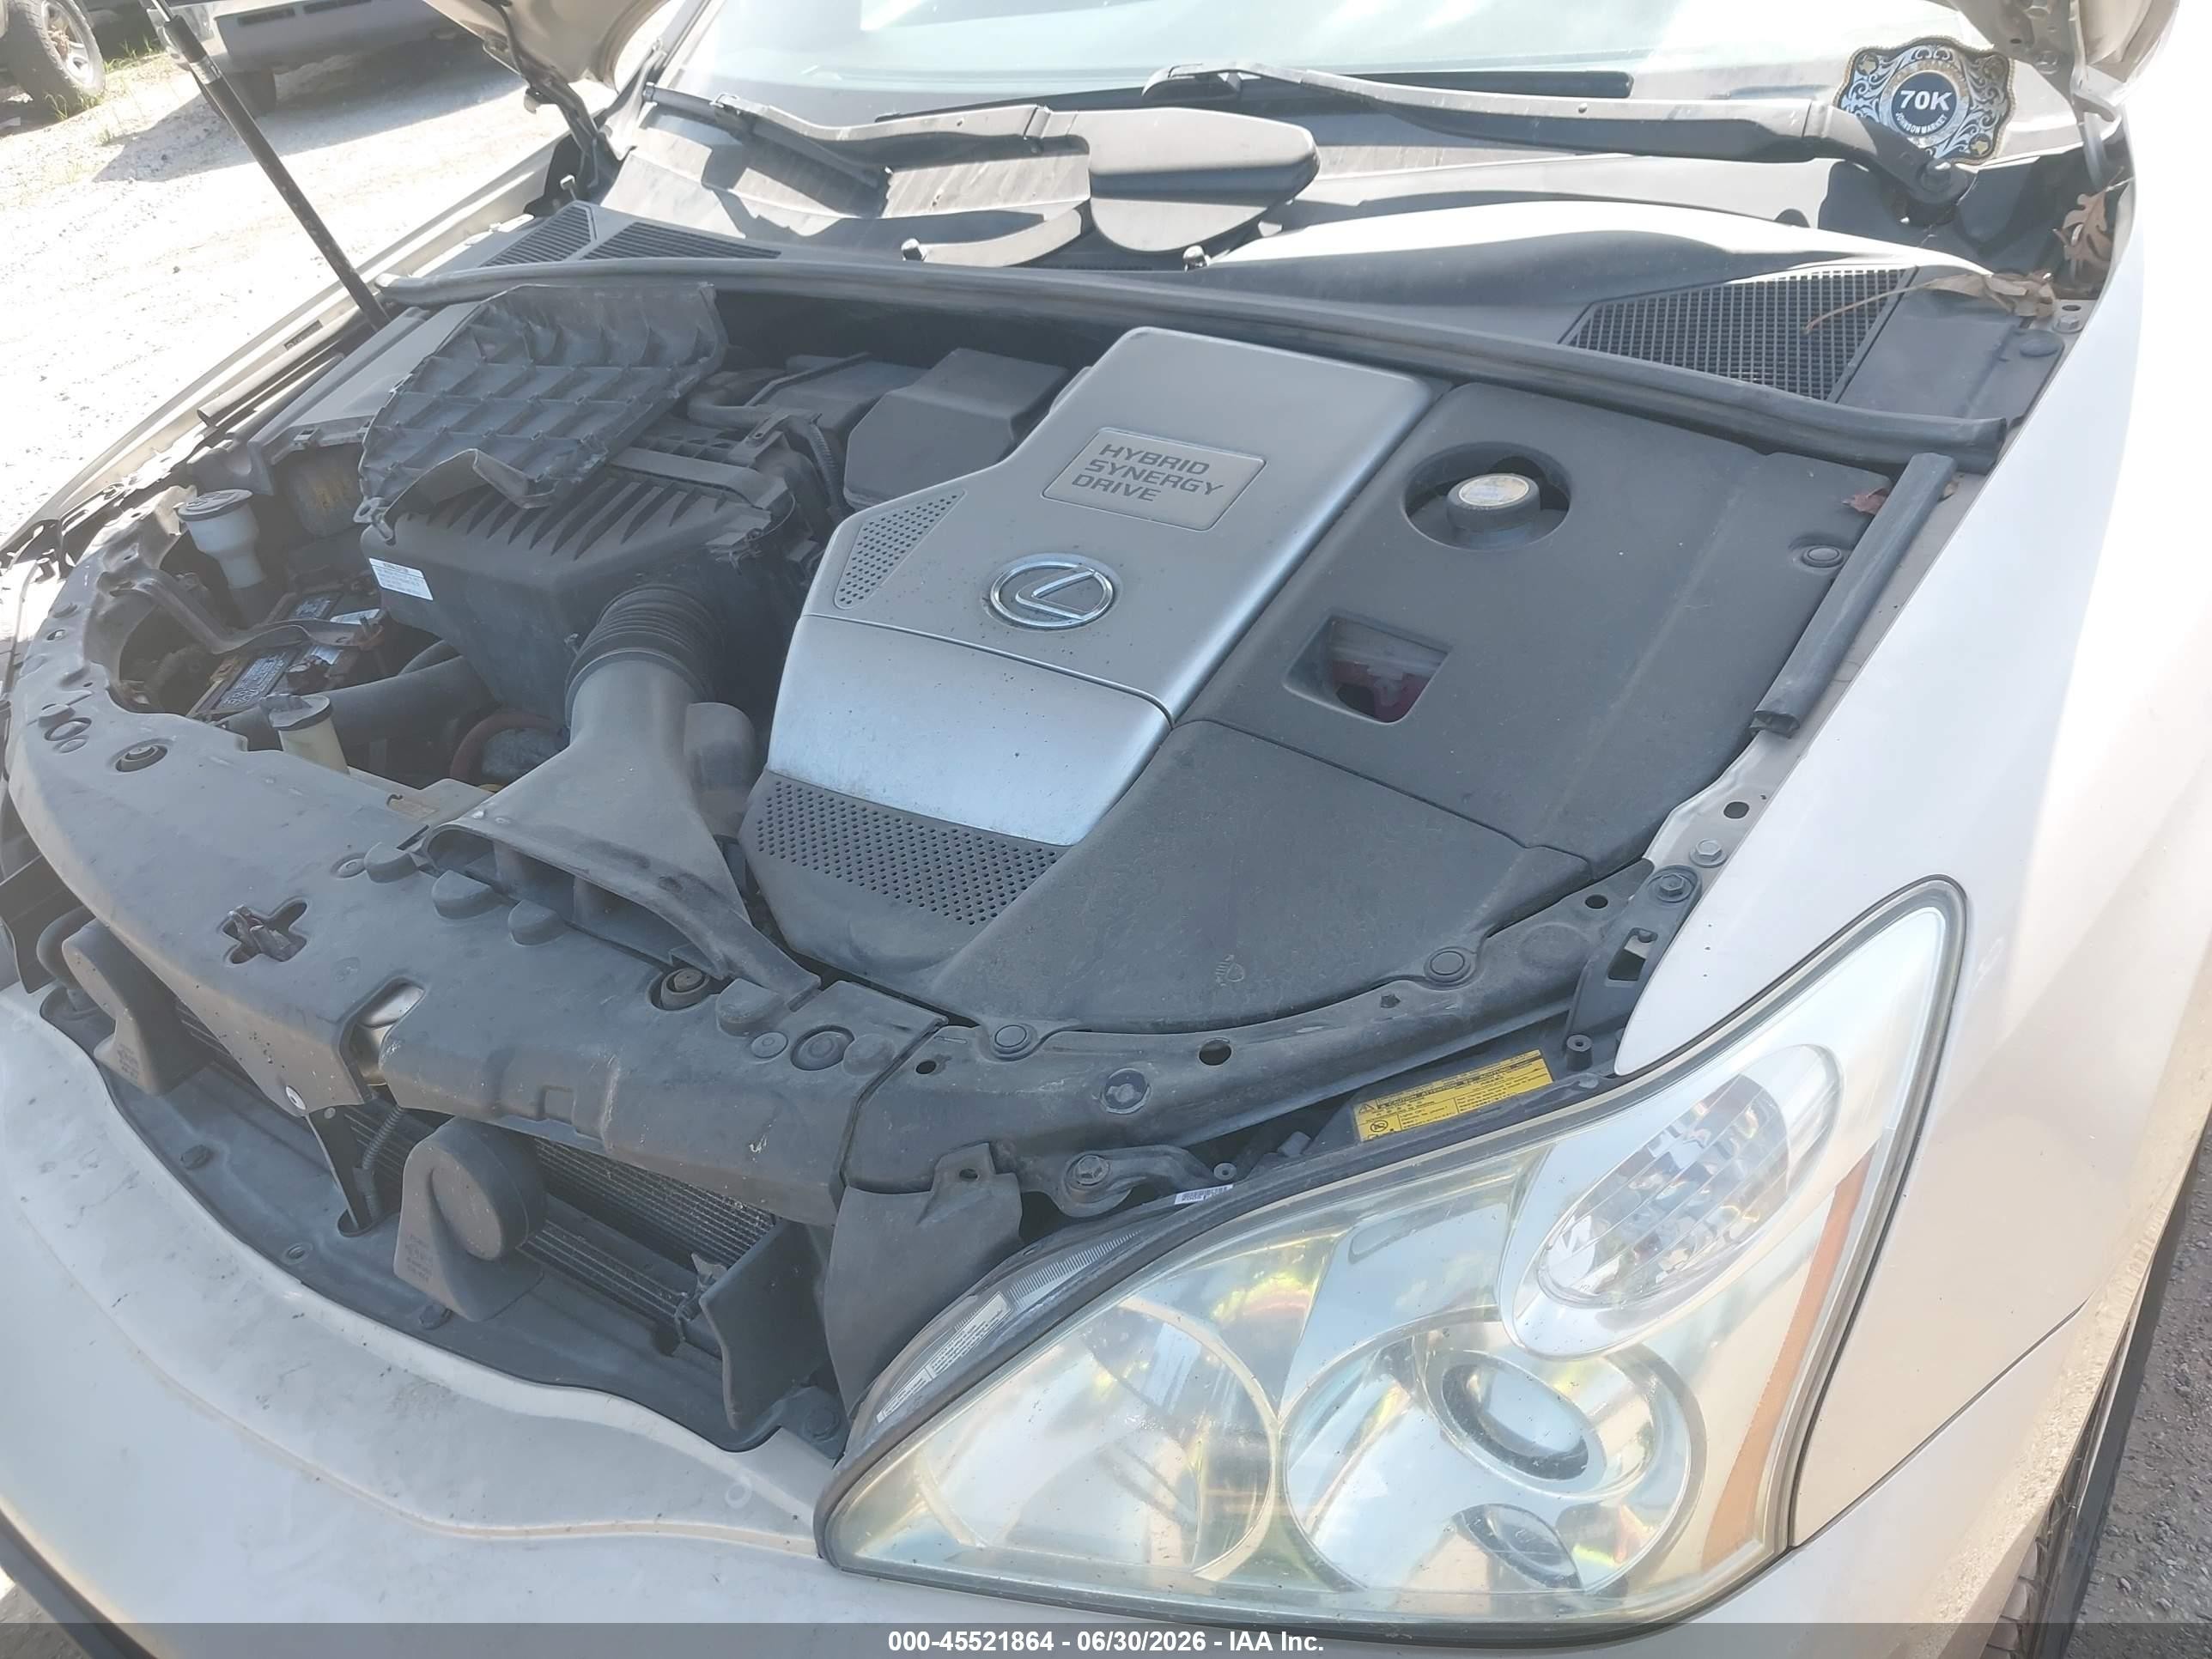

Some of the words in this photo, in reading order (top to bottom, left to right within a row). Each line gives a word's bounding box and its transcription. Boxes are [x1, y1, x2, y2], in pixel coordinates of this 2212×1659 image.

[1900, 90, 1953, 111] 70K
[1895, 112, 1922, 134] JOHNSON
[1922, 113, 1948, 134] MARKET
[1098, 444, 1210, 475] HYBRID
[1072, 473, 1161, 501] DRIVE
[1085, 459, 1224, 495] SYNERGY
